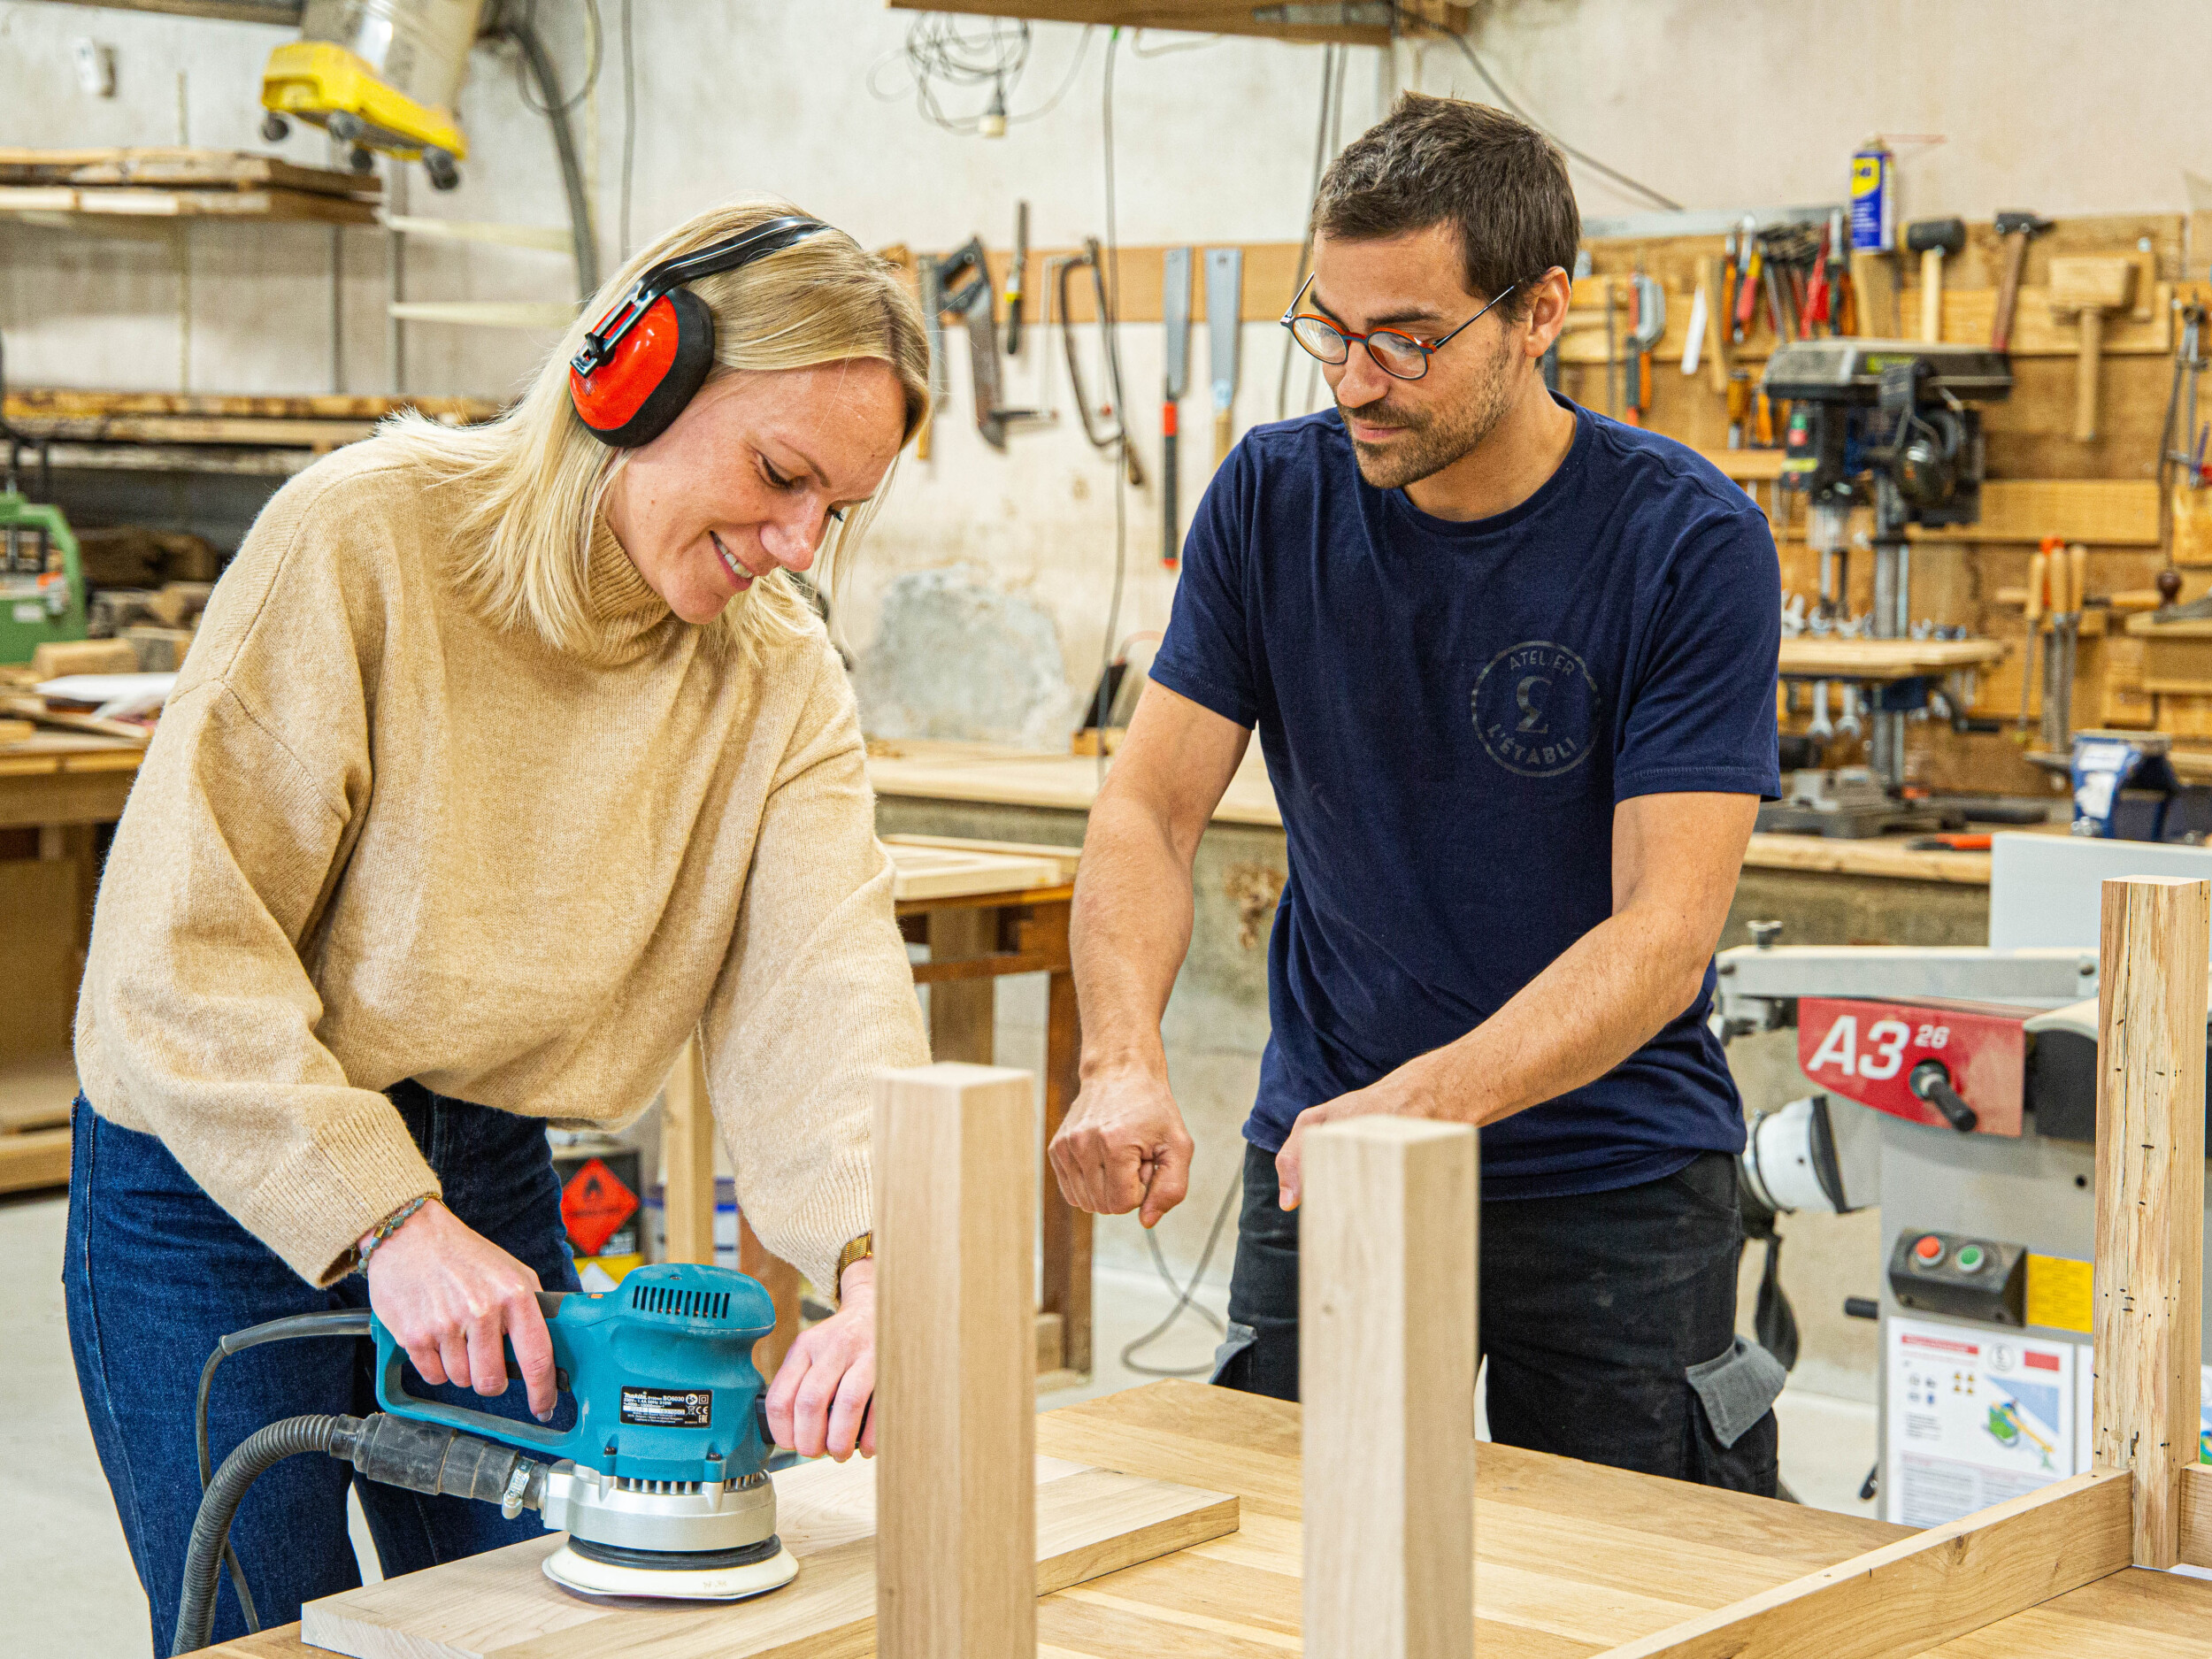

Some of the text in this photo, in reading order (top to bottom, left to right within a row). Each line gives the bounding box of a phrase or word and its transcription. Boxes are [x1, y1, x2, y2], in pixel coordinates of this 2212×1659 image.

[1509, 649, 1576, 677] ATELIER
[1807, 1015, 1951, 1080] A3 26
